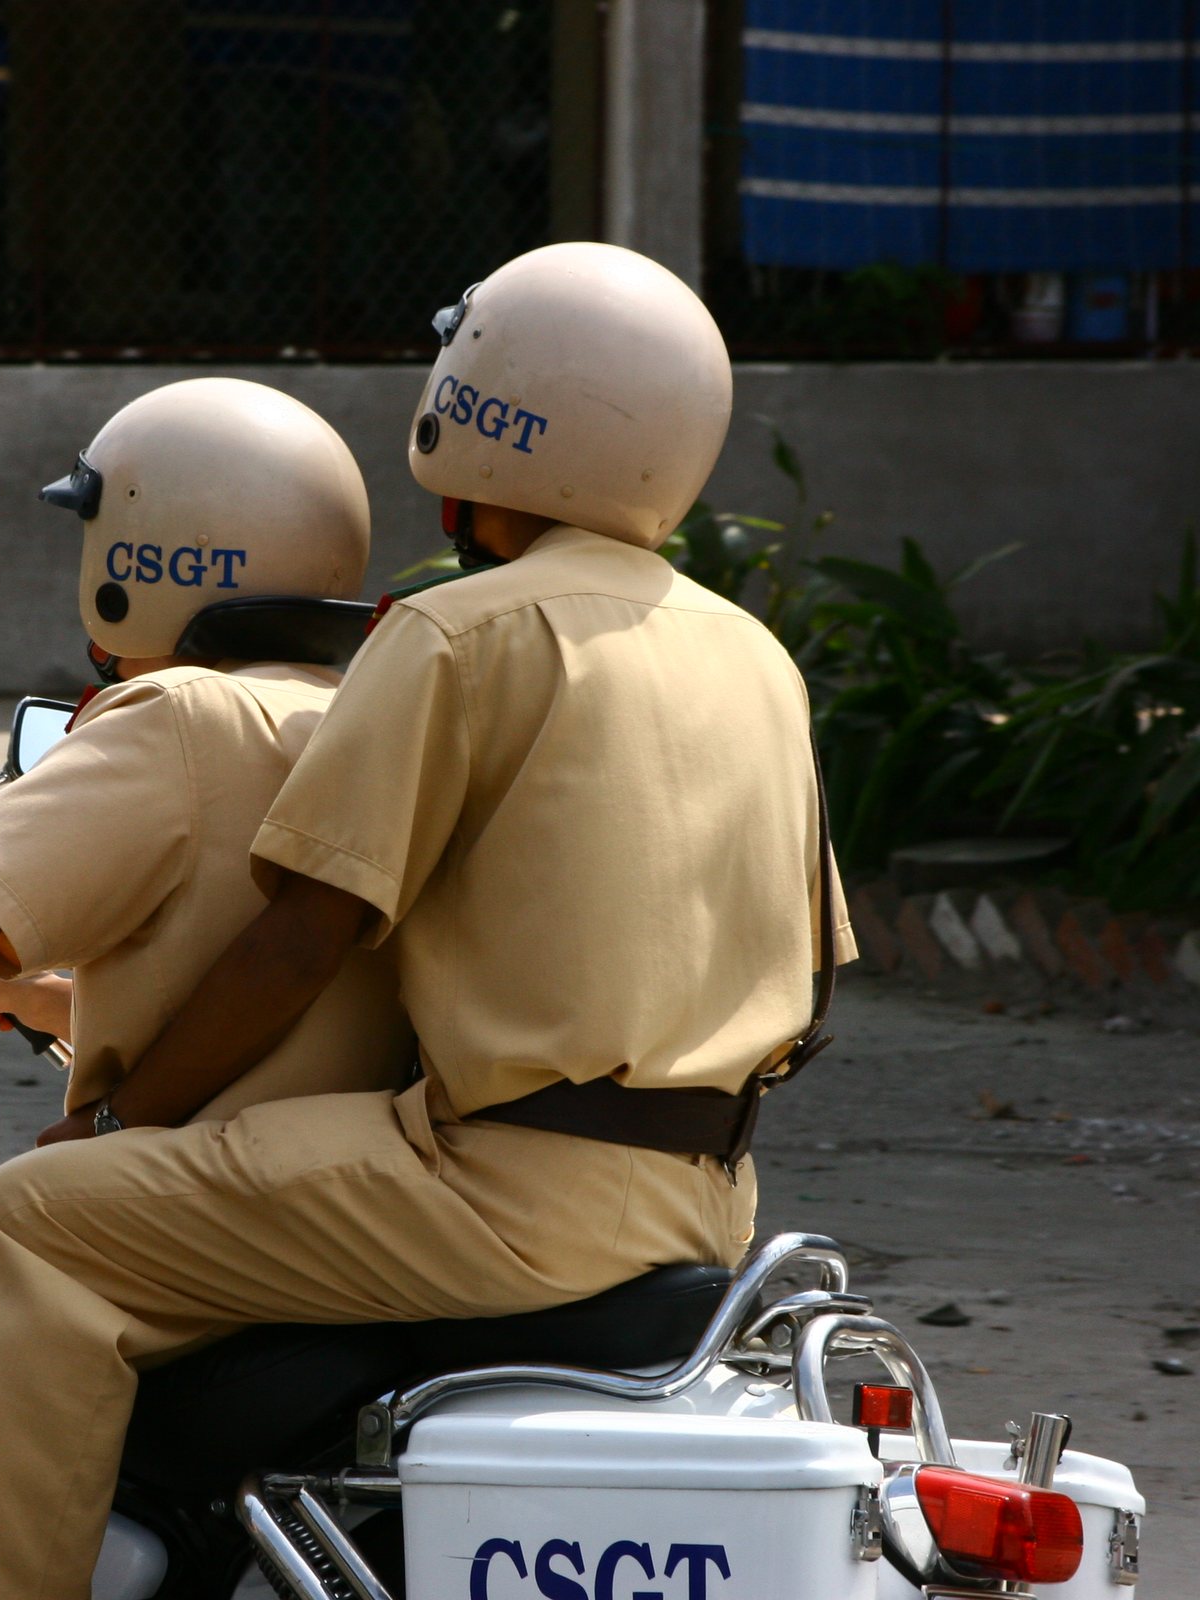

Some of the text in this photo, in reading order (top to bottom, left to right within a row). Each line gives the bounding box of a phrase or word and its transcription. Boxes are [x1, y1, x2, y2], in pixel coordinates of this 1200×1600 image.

[434, 375, 548, 454] CSGT
[106, 541, 246, 588] CSGT
[470, 1538, 731, 1600] CSGT
